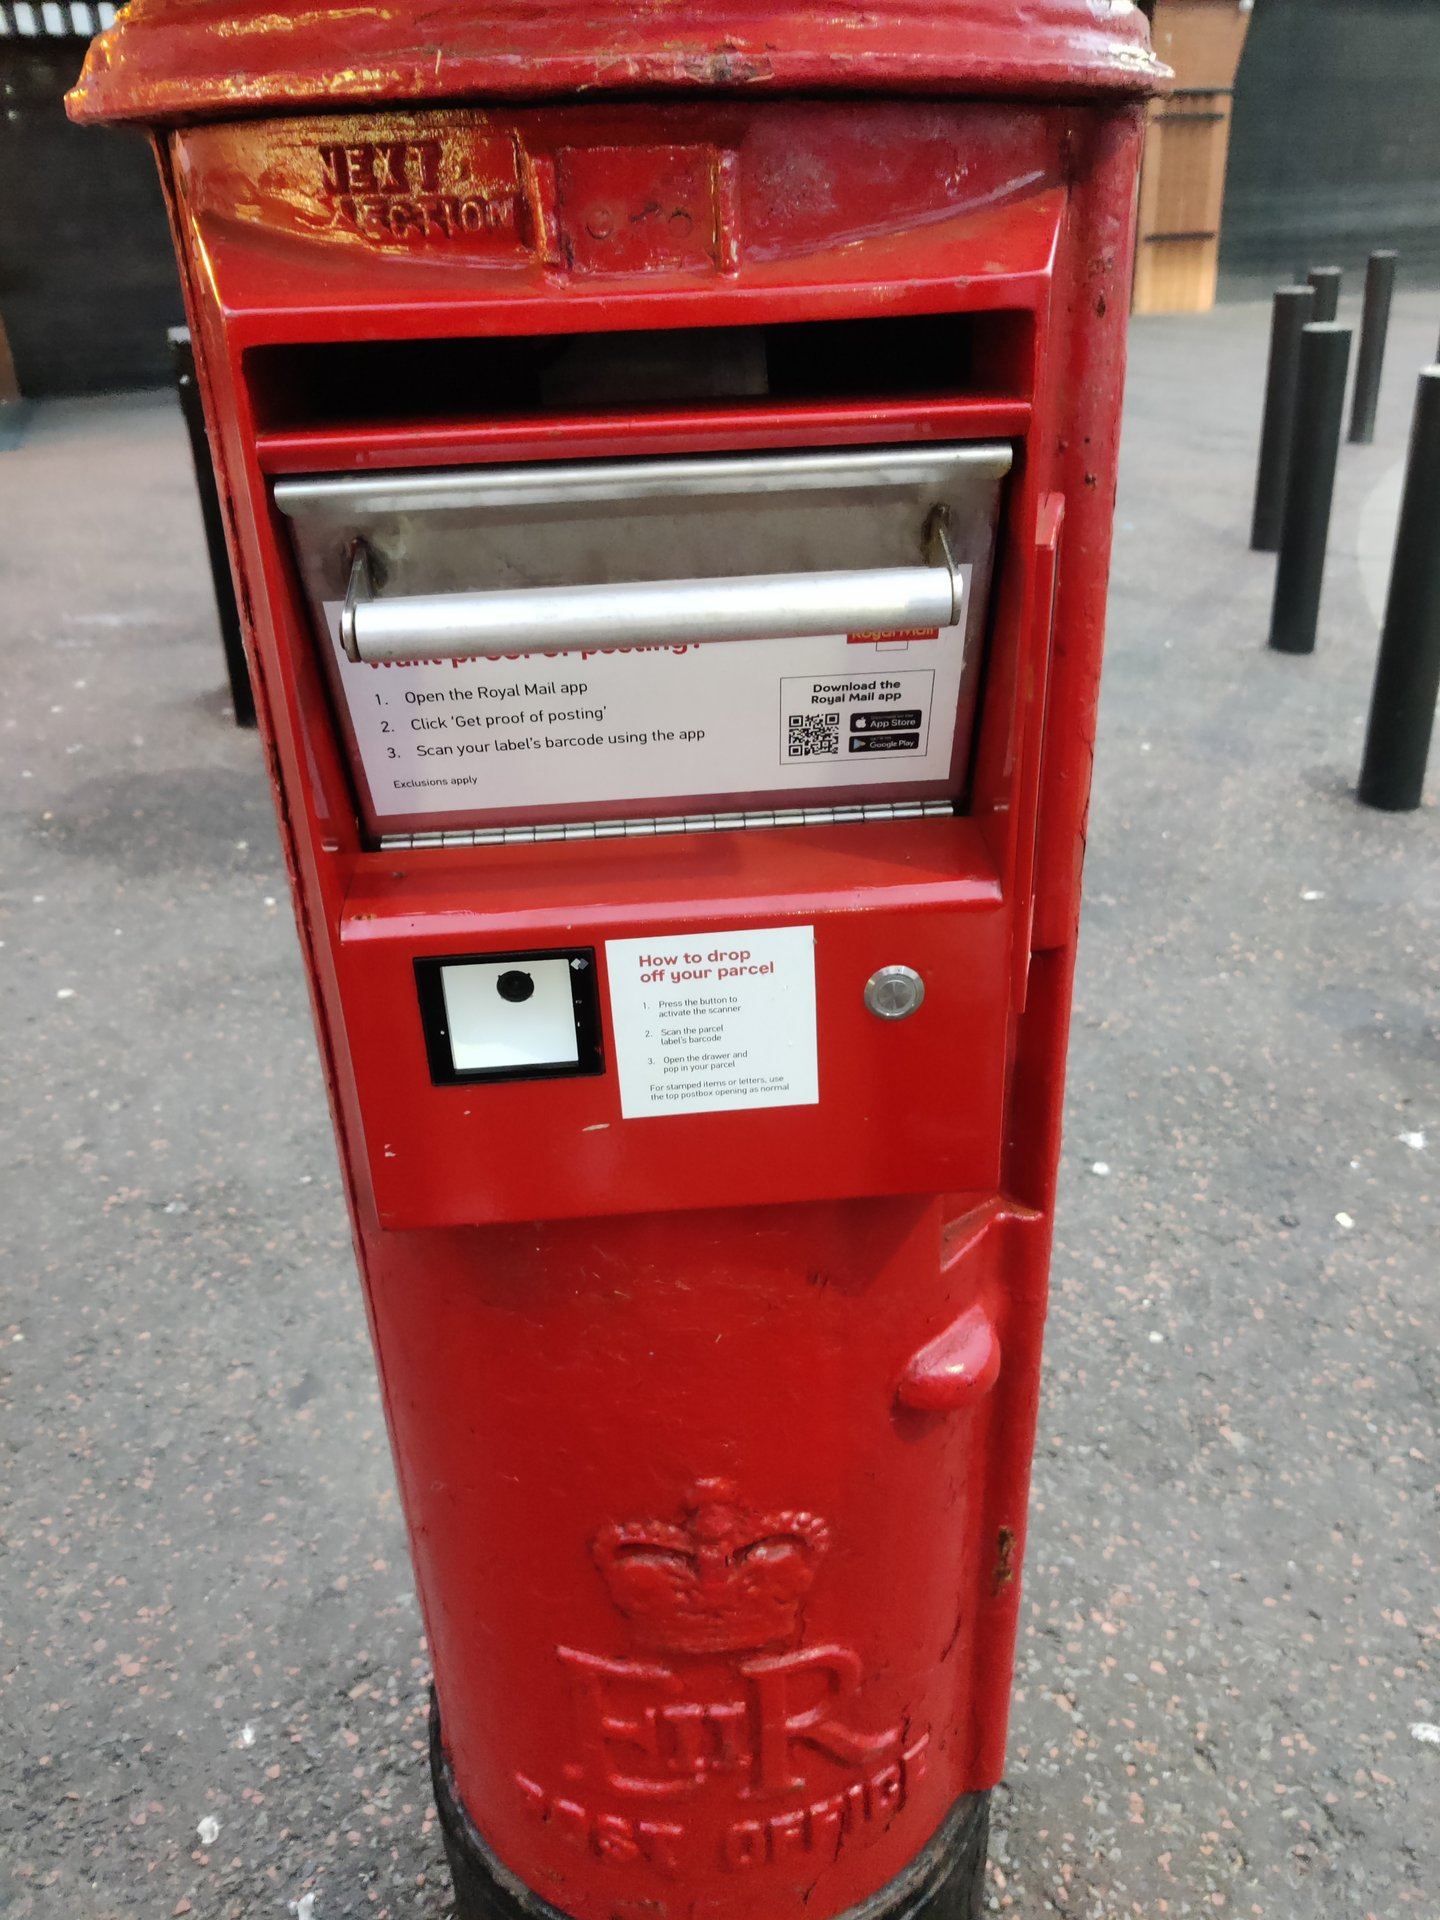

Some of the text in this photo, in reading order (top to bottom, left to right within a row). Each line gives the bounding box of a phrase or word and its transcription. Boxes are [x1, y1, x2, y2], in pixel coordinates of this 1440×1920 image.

[813, 680, 901, 693] Download the
[375, 682, 589, 706] 1. Open the Royal Mail app
[811, 692, 902, 705] Royal Mail app
[380, 720, 395, 733] 2.
[410, 716, 448, 731] Click
[485, 711, 526, 727] proof
[529, 710, 546, 723] of
[870, 719, 916, 729] App Store
[387, 729, 705, 759] 3. Scan your label's barcode using the app
[870, 739, 915, 749] Google Play
[393, 775, 478, 789] Exclusions apply
[639, 949, 751, 968] How to drop
[640, 961, 774, 984] off your parcel
[659, 1000, 683, 1009] Press
[684, 998, 698, 1007] the
[700, 996, 728, 1006] button
[729, 996, 738, 1004] to
[659, 1005, 742, 1018] activate the scanner
[645, 1024, 724, 1038] 2. Scan the parcel
[688, 1034, 722, 1044] barcode
[648, 1050, 748, 1065] 3. Open the drawer and
[663, 1060, 736, 1074] pop in your parcel
[650, 1084, 664, 1092] For
[666, 1081, 701, 1091] stamped
[703, 1079, 727, 1088] items
[769, 1075, 784, 1083] use
[650, 1093, 664, 1101] the
[666, 1091, 679, 1100] top
[681, 1089, 713, 1100] postbox
[715, 1087, 747, 1097] opening
[760, 1083, 790, 1093] normal
